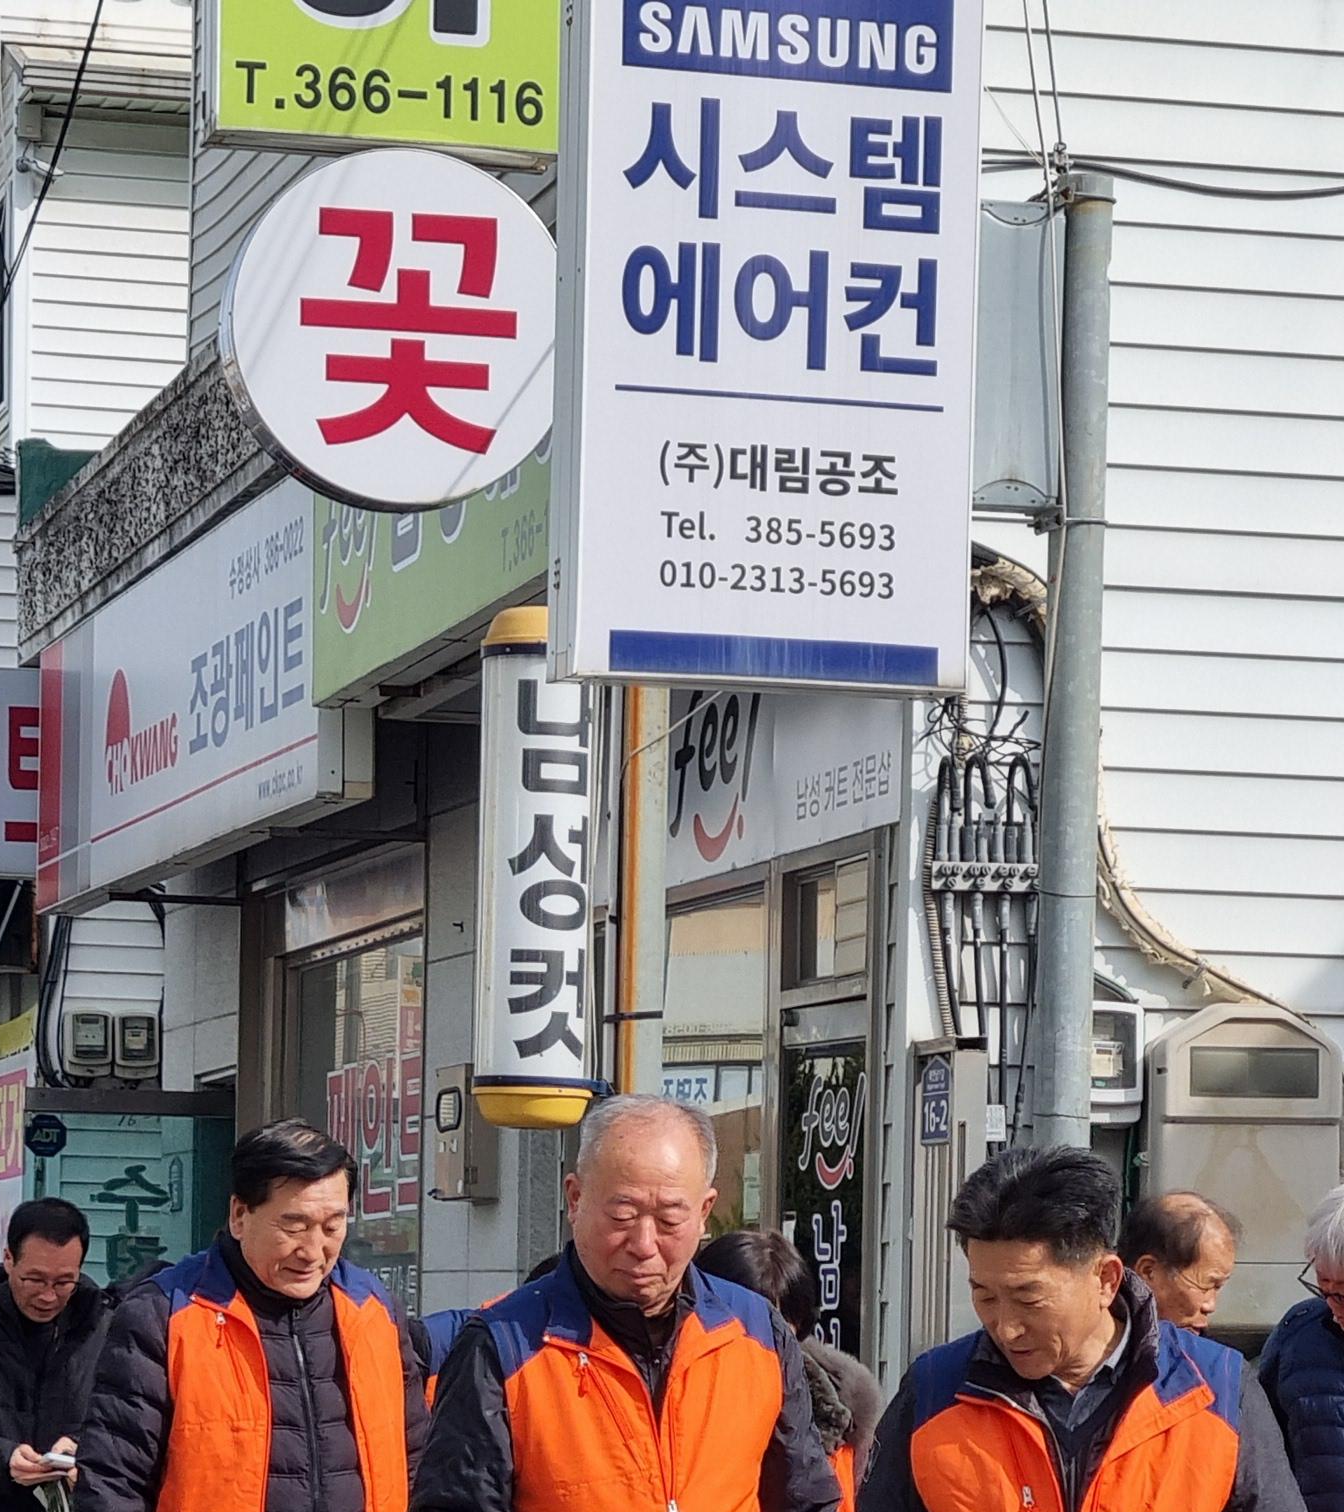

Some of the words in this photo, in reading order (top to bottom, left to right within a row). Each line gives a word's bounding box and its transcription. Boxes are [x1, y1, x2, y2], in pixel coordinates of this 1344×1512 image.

[638, 1, 937, 75] SAMSUNG
[235, 59, 544, 127] T.366-1116
[622, 97, 943, 235] 시스템
[299, 206, 518, 456] 꽃
[621, 241, 938, 377] 에어컨
[659, 439, 899, 497] (주)대림공조
[660, 510, 716, 542] Tel.
[744, 515, 896, 552] 385-5693
[659, 559, 895, 601] 010-2313-5693
[189, 596, 305, 756] 조광페인트
[796, 770, 821, 821] 남성
[852, 750, 892, 805] 전문샵
[506, 678, 591, 1062] 남성컷
[31, 1127, 58, 1143] ADT
[327, 1050, 421, 1224] 페인트
[924, 1099, 948, 1133] 16-2
